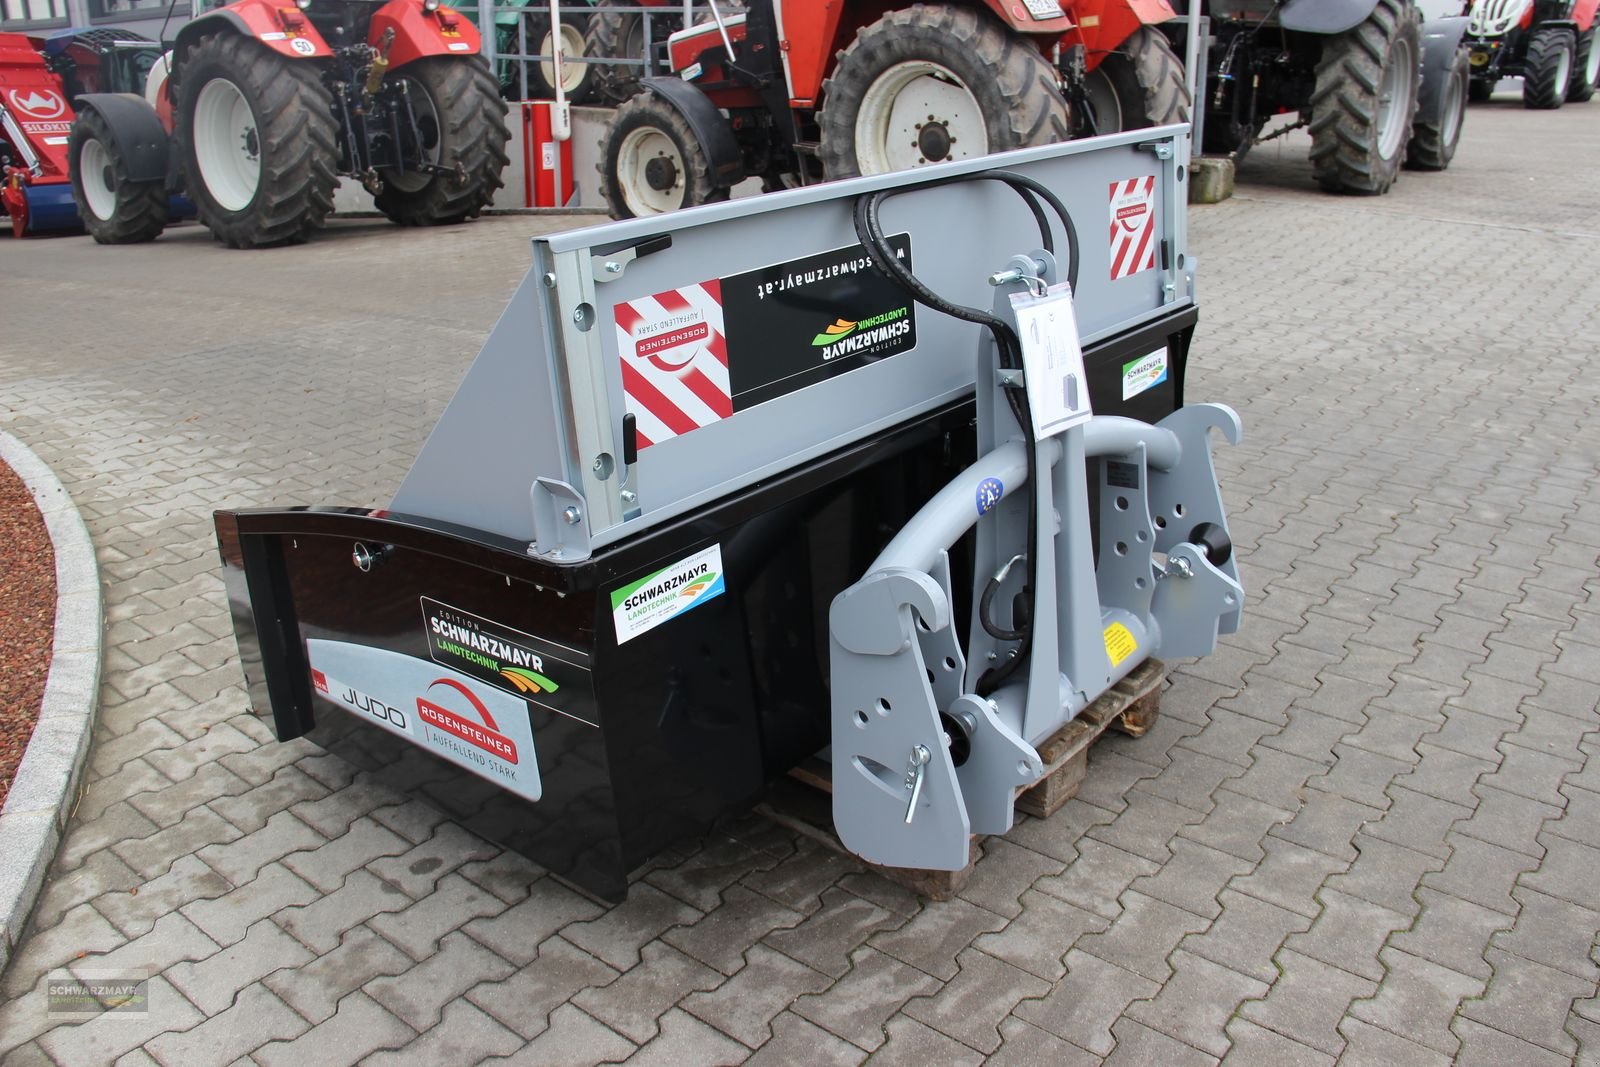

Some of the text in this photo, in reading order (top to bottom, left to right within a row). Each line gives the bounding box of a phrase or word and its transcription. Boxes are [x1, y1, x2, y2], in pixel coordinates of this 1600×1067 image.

[637, 311, 699, 335] AUFFALLEND STARK
[857, 306, 908, 331] LANDTECHNIK
[638, 325, 707, 353] ROSENSTEINER
[822, 318, 910, 361] SCHWARZMAYR
[870, 337, 903, 354] EDITION
[1127, 358, 1161, 380] SCHWARZMAYR
[986, 489, 995, 506] A
[624, 562, 708, 611] SCHWARZMAYR
[439, 610, 480, 630] EDITION
[626, 591, 678, 621] LANDTECHNIK
[431, 616, 545, 673] SCHWARZMAYR
[436, 637, 500, 672] LANDTECHNIK
[342, 687, 406, 729] JUDO
[421, 704, 512, 756] ROSENSTEINER
[432, 732, 518, 782] AUFFALLEND STARK
